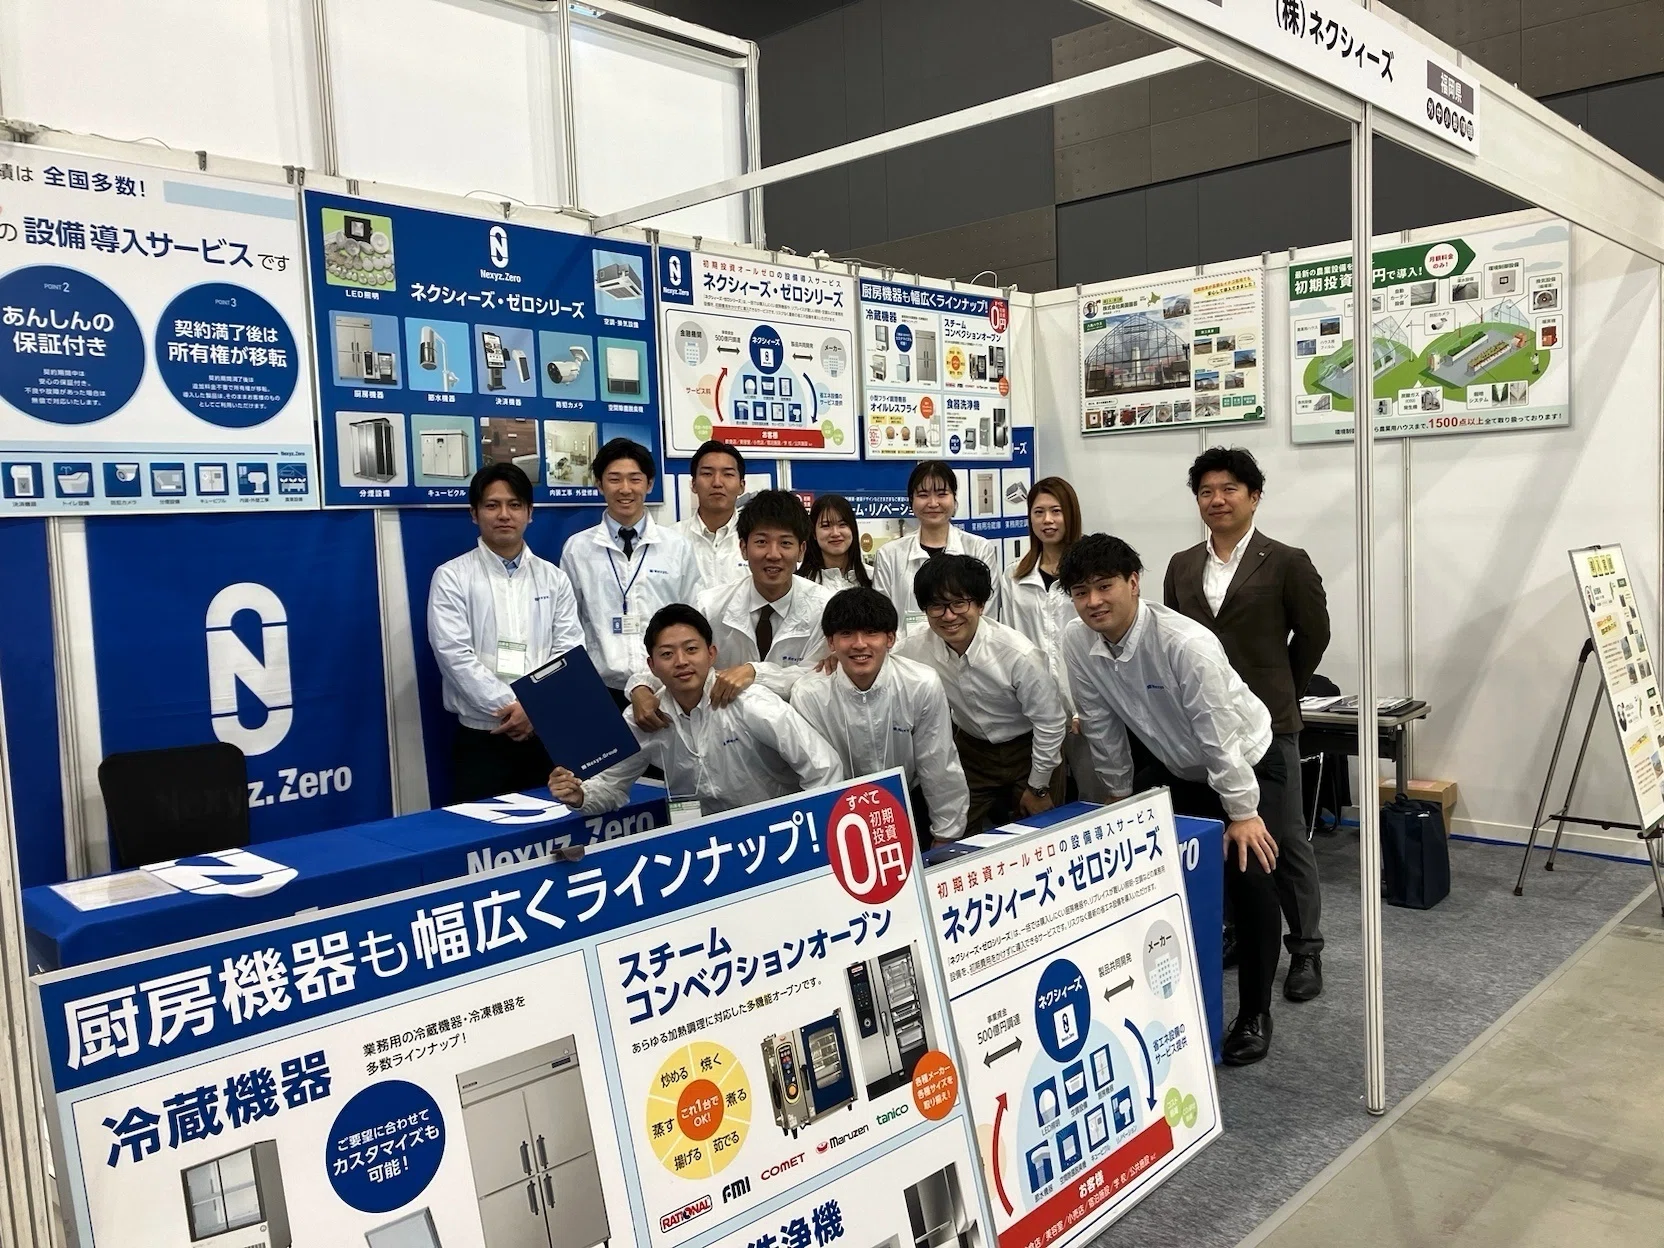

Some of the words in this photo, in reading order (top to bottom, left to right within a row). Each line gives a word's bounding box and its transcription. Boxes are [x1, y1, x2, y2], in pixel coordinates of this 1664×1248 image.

[1441, 72, 1463, 104] 福岡県
[43, 166, 145, 197] 全国多数!
[1429, 253, 1454, 263] 月額料金
[1432, 261, 1449, 269] のみ!
[480, 269, 521, 283] Nexyz.Zero
[1294, 276, 1352, 295] 初期投資
[345, 289, 379, 300] LED照明
[410, 283, 586, 320] ネクシィーズ・ゼロシリーズ
[703, 272, 844, 308] ネクシィーズ・ゼロシリーズ
[862, 283, 988, 313] 厨房機器も幅広くラインナップ!
[2, 305, 114, 332] あんしんの
[866, 308, 897, 323] 冷蔵機器
[944, 318, 966, 329] スチーム
[174, 319, 278, 343] 契約満了後は
[752, 336, 781, 346] ネクシィーズ
[13, 330, 107, 357] 保証付き
[168, 341, 287, 368] 所有権が移転
[556, 401, 584, 410] 防犯カメラ
[427, 489, 467, 497] キュービクル
[846, 789, 880, 811] すべて
[869, 807, 896, 828] 初期
[872, 824, 898, 845] 投資
[937, 808, 1155, 900] 初期投資オールゼロの設備導入サービス
[941, 825, 1163, 945] ネクシィーズ・ゼロシリーズ
[65, 809, 819, 1071] 厨房機器も幅広くラインナップ!
[1148, 935, 1172, 953] メーカー
[618, 927, 732, 989] スチーム
[625, 909, 893, 1025] コンベクションオーブン
[1038, 975, 1083, 1010] ネクシィーズ
[362, 996, 526, 1058] 業務用の冷蔵機器・冷凍機器を
[631, 977, 823, 1054] あらゆる加熱調理に対応した多機能オーブンです。
[366, 1032, 468, 1077] 多数ラインナップ!
[700, 1053, 722, 1072] 焼く
[660, 1067, 689, 1088] 炒める
[915, 1065, 951, 1087] 各種メーカー
[917, 1076, 954, 1100] 各種サイズを
[101, 1049, 333, 1168] 冷蔵機器
[681, 1095, 719, 1119] これ1台で
[725, 1088, 747, 1108] 煮る
[337, 1108, 430, 1151] ご要望に合わせて
[652, 1118, 675, 1139] 蒸す
[693, 1112, 712, 1127] OK!
[332, 1125, 441, 1177] カスタマイズも
[713, 1131, 740, 1153] 茹でる
[367, 1156, 410, 1184] 可能!
[662, 1197, 711, 1230] RATIONAL
[722, 1176, 751, 1204] FMI
[760, 1153, 806, 1181] COMET
[829, 1122, 870, 1151] Maruzen
[876, 1104, 909, 1126] tanico
[674, 1147, 702, 1171] 揚げる
[1078, 1169, 1105, 1199] お客様
